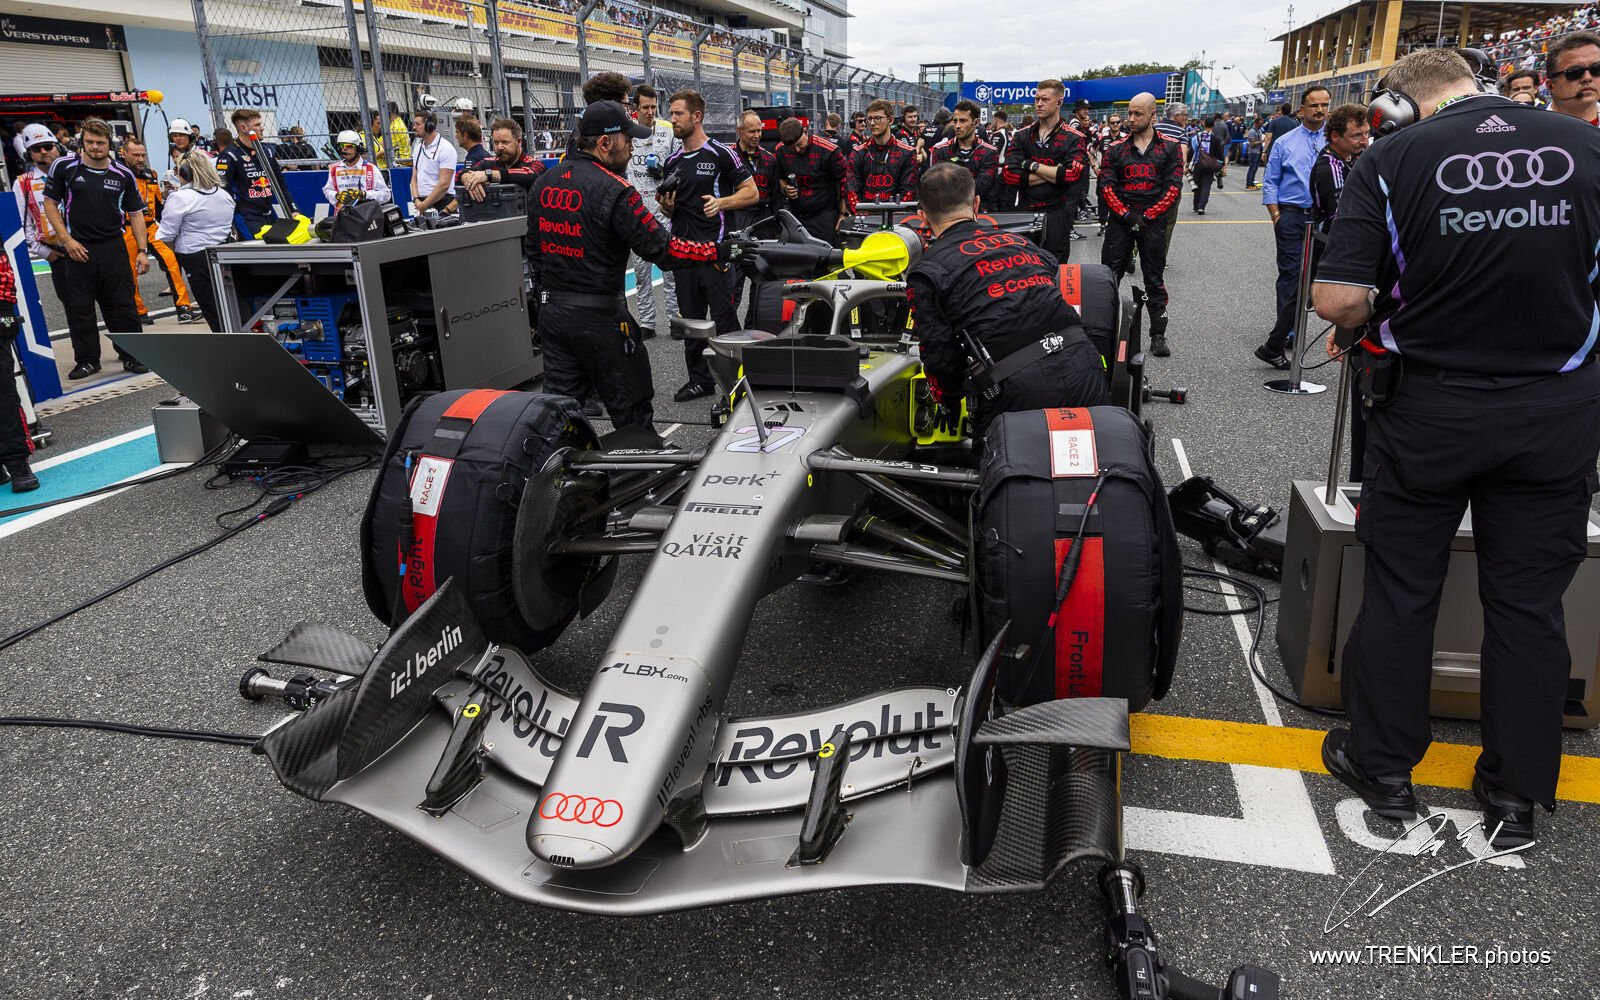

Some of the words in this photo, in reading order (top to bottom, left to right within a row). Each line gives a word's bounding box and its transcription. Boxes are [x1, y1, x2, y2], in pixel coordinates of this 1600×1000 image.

[3, 30, 90, 44] VERSTAPPEN
[993, 86, 1071, 100] cryptom
[1475, 123, 1517, 134] adidas
[539, 217, 582, 237] Revolut
[1440, 199, 1572, 236] Revolut
[450, 297, 519, 325] PIQUADRO
[724, 425, 807, 454] 27
[1067, 436, 1079, 460] RACE
[419, 476, 434, 506] RACE
[684, 502, 762, 516] PIRELLI
[662, 542, 742, 560] QATAR
[692, 531, 749, 547] visit
[409, 537, 425, 589] Right
[415, 625, 464, 679] berlin
[1070, 631, 1089, 680] Front
[468, 655, 570, 761] Revolu
[576, 702, 646, 764] R
[717, 702, 944, 787] Revolut
